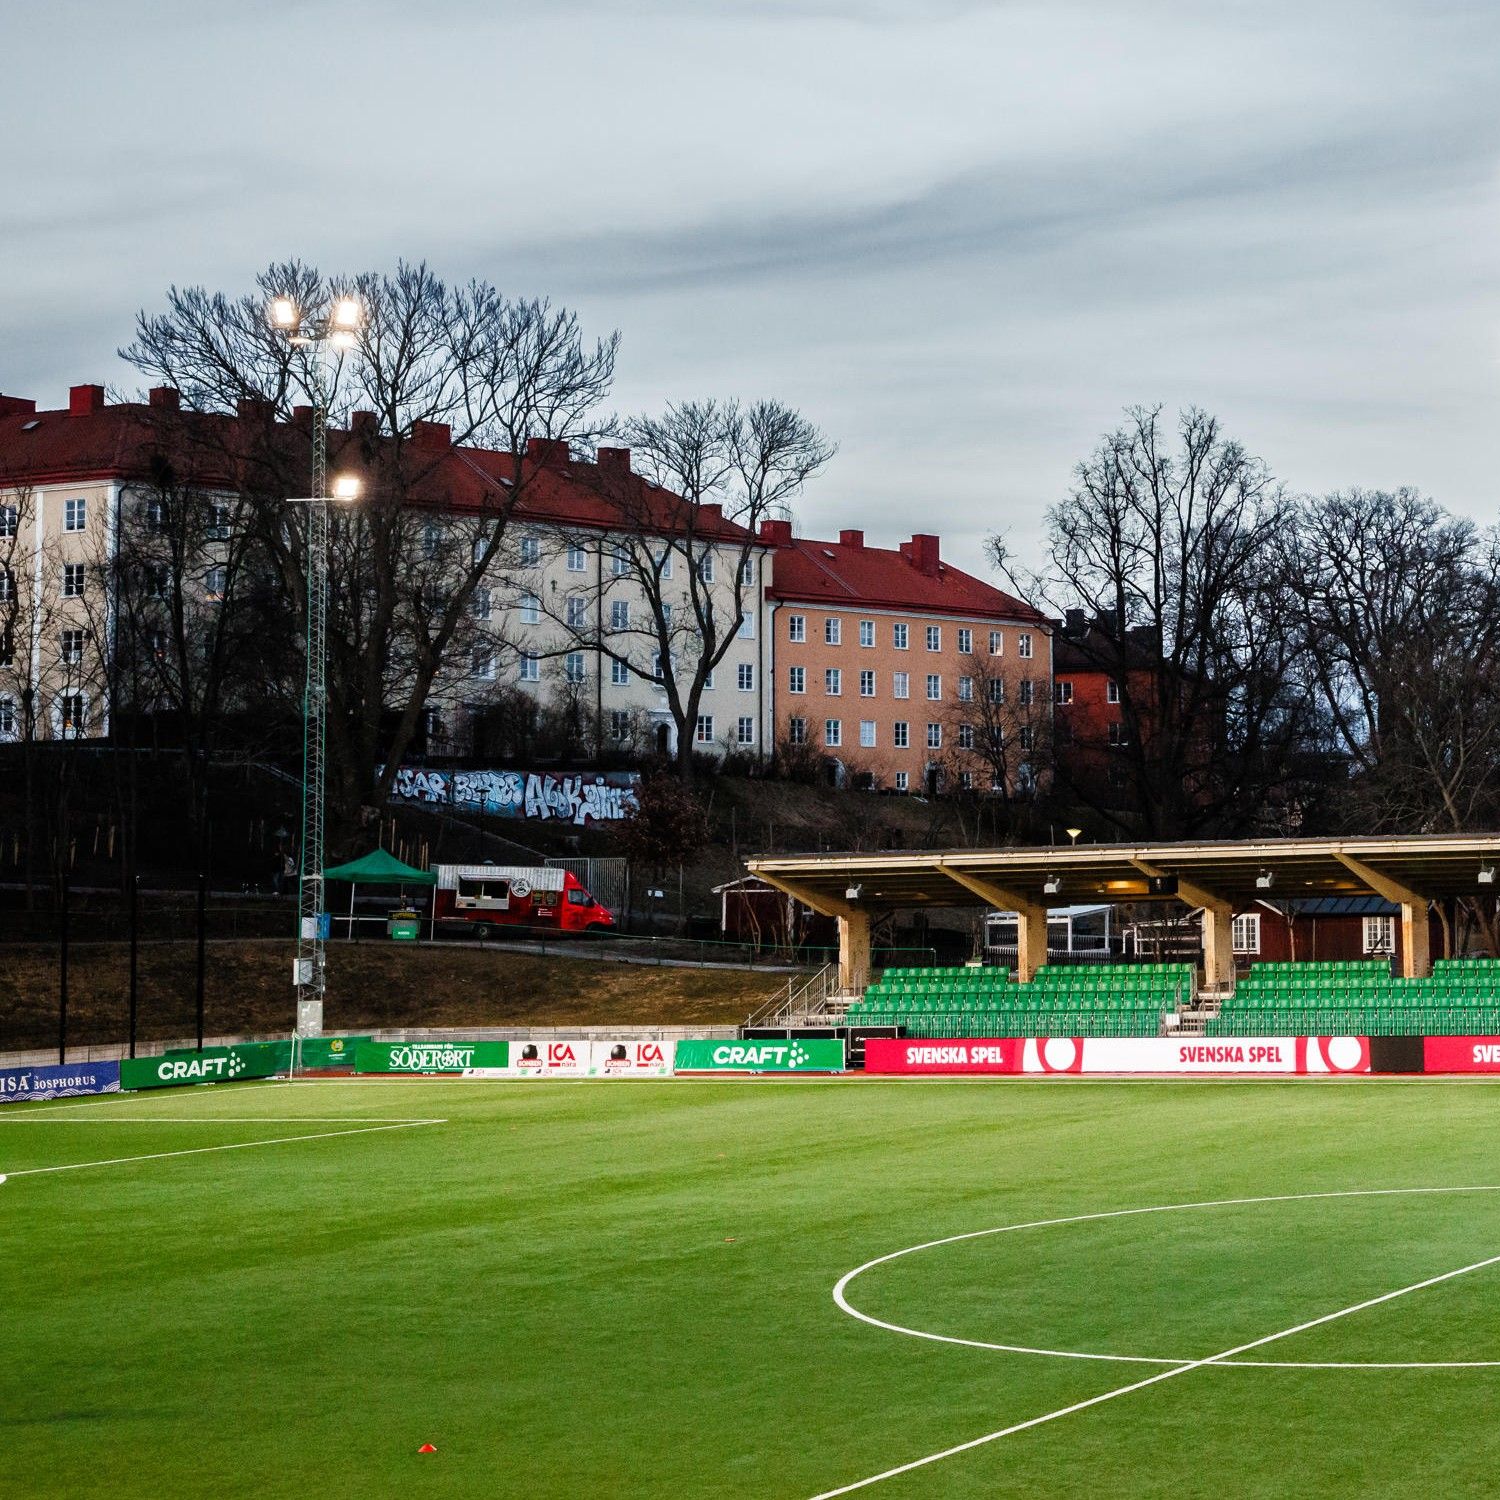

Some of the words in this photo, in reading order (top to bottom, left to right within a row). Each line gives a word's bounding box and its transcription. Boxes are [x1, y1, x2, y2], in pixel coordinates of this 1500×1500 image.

[388, 1046, 475, 1070] SÖDERORT
[548, 1043, 576, 1061] ICA
[636, 1043, 664, 1062] ICA
[712, 1046, 789, 1065] CRAFT
[906, 1046, 968, 1064] SVENSKA
[970, 1046, 1003, 1063] SPEL
[1178, 1045, 1245, 1064] SVENSKA
[1247, 1045, 1283, 1063] SPEL
[157, 1057, 228, 1080] CRAFT
[33, 1075, 97, 1090] BOSPHORUS
